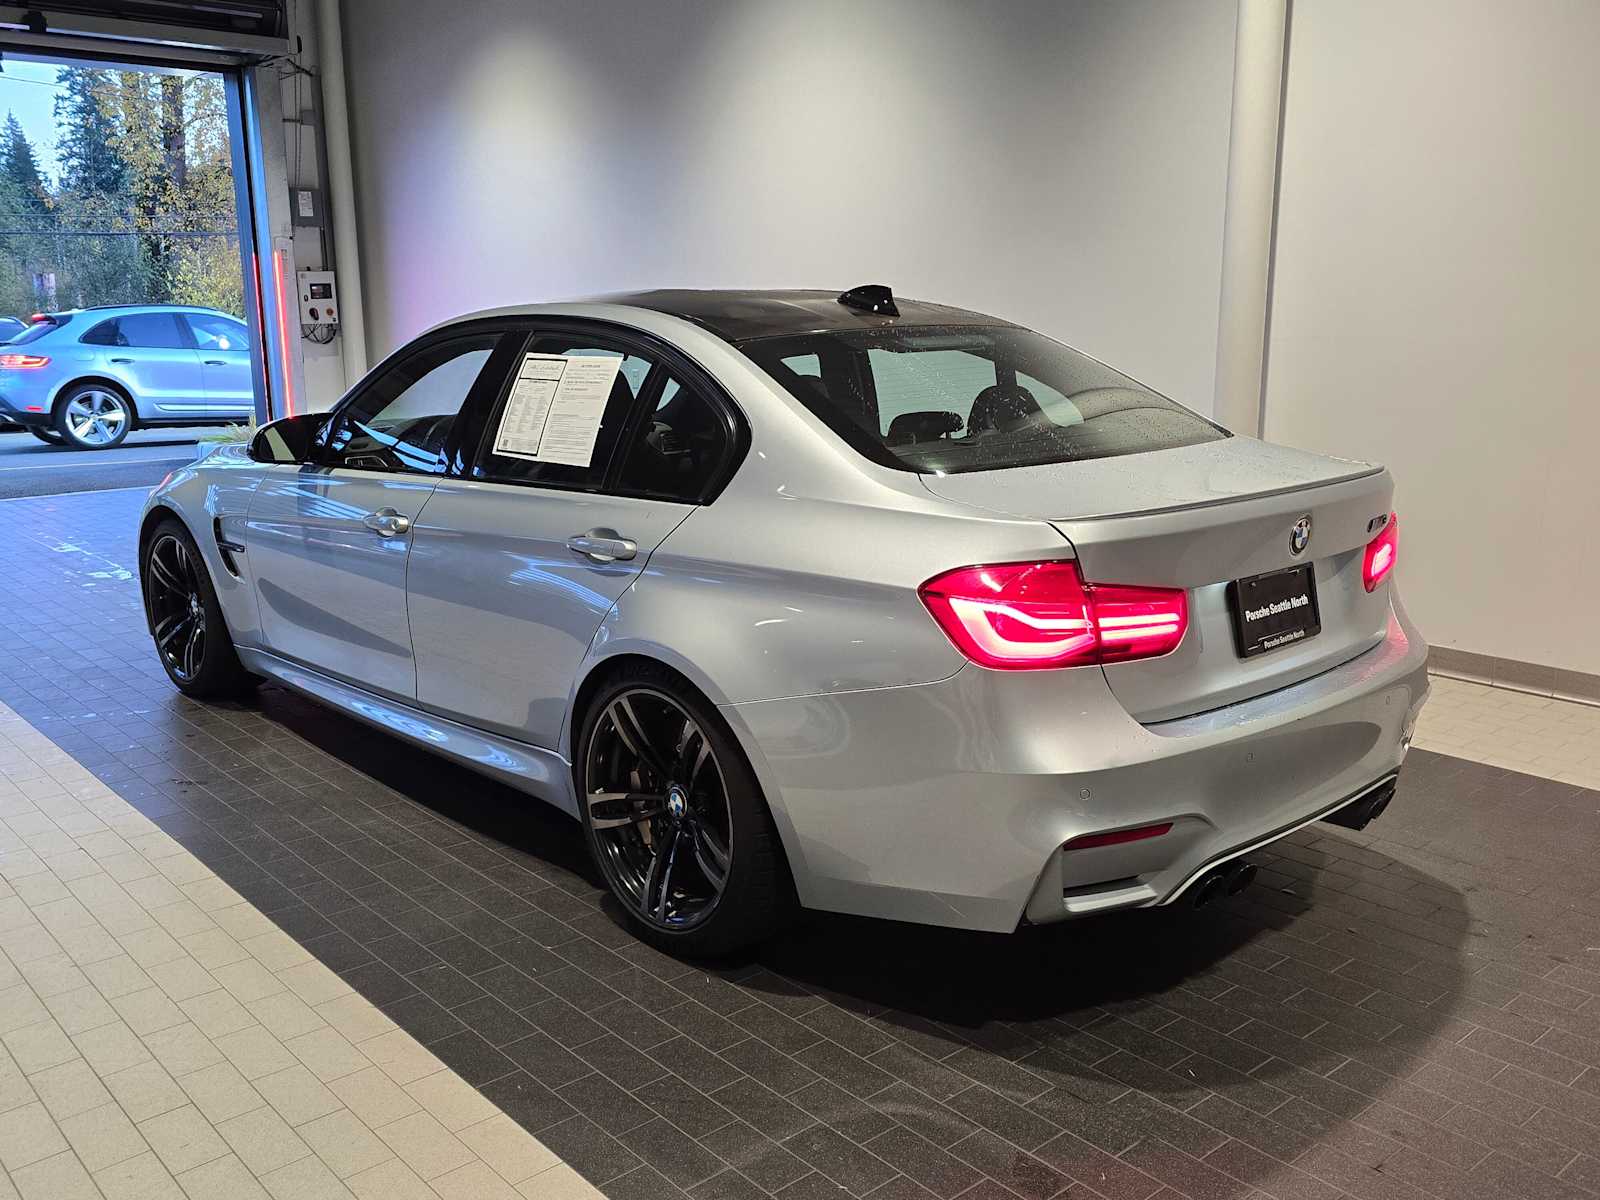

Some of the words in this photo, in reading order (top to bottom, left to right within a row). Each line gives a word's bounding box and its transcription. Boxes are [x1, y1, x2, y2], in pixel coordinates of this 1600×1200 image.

[1245, 606, 1270, 622] Porsche
[1269, 599, 1291, 615] Seattle
[1291, 594, 1309, 609] North
[1264, 637, 1280, 649] Porsche
